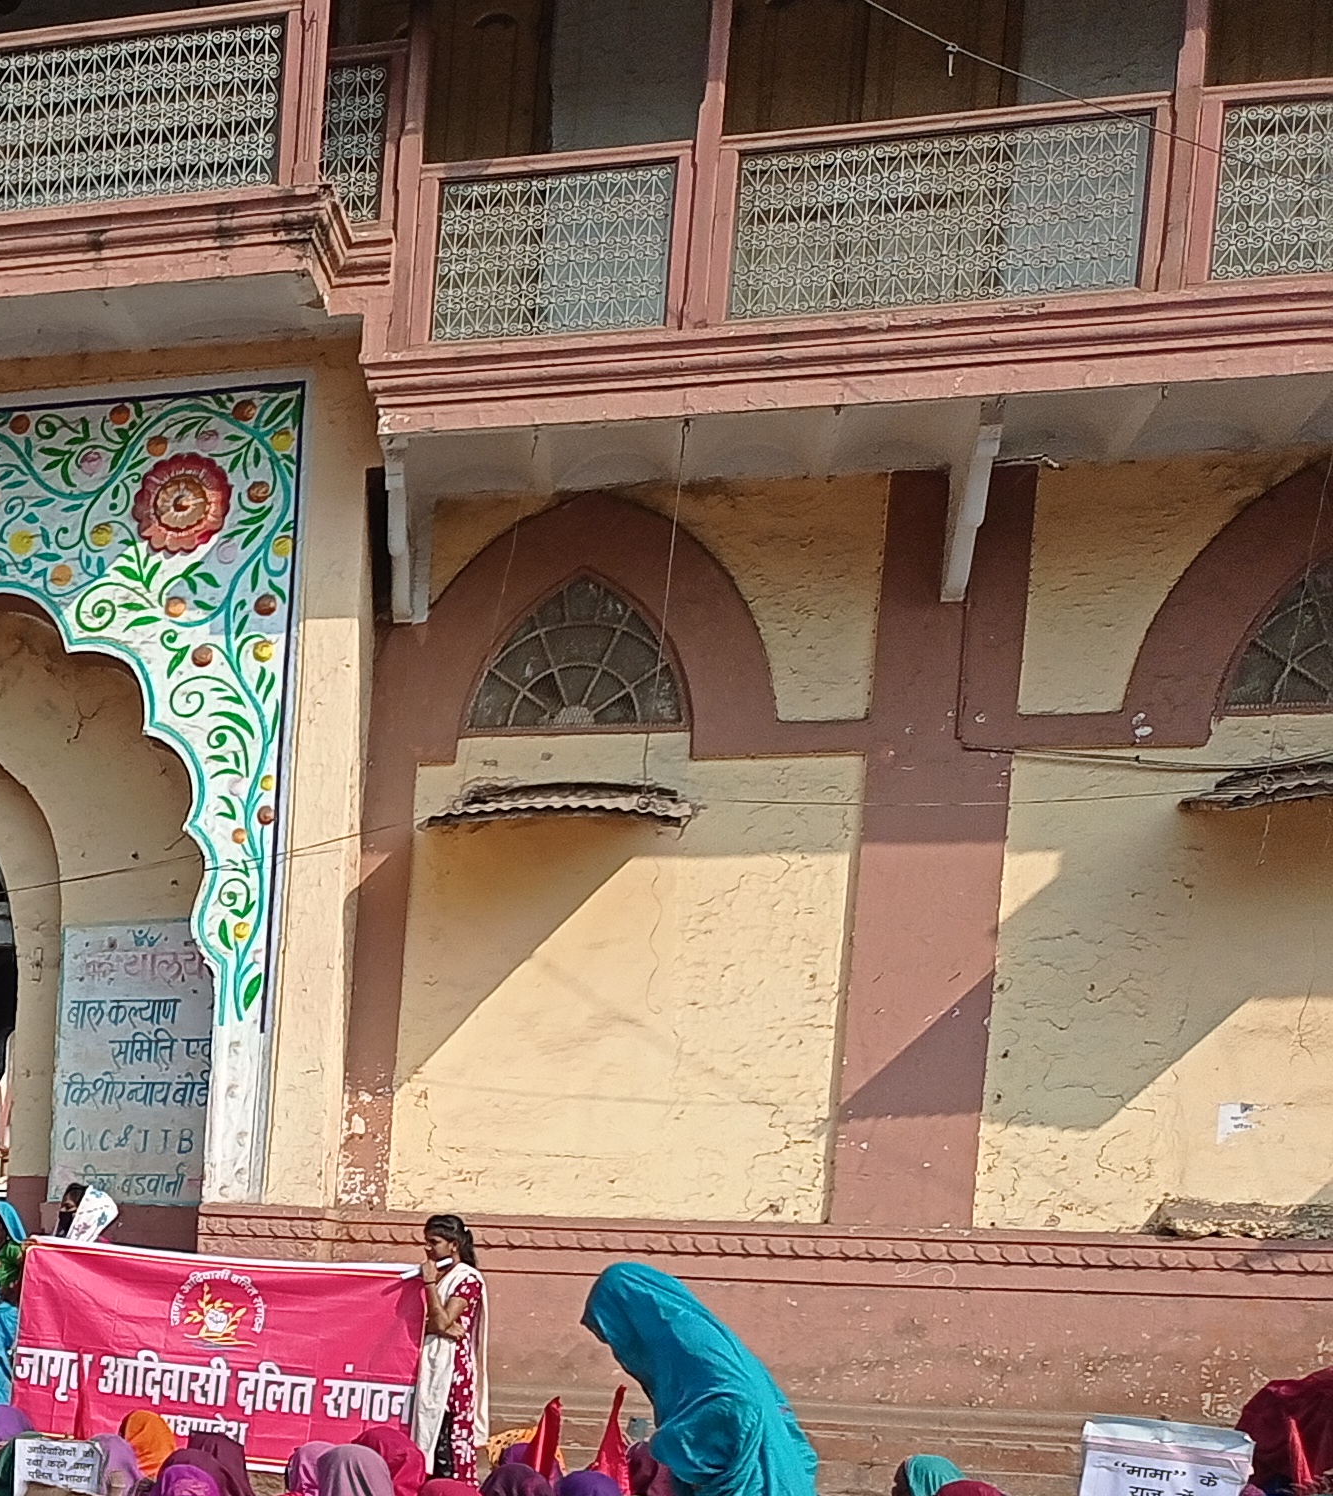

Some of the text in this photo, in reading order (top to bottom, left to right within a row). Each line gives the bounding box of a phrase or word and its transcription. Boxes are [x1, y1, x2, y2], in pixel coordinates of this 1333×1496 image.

[67, 998, 182, 1032] बाल कल्याण
[98, 1349, 232, 1406] आदिवासी
[237, 1361, 316, 1416] दलित
[321, 1363, 415, 1425] संगठन
[1198, 1471, 1220, 1488] के
